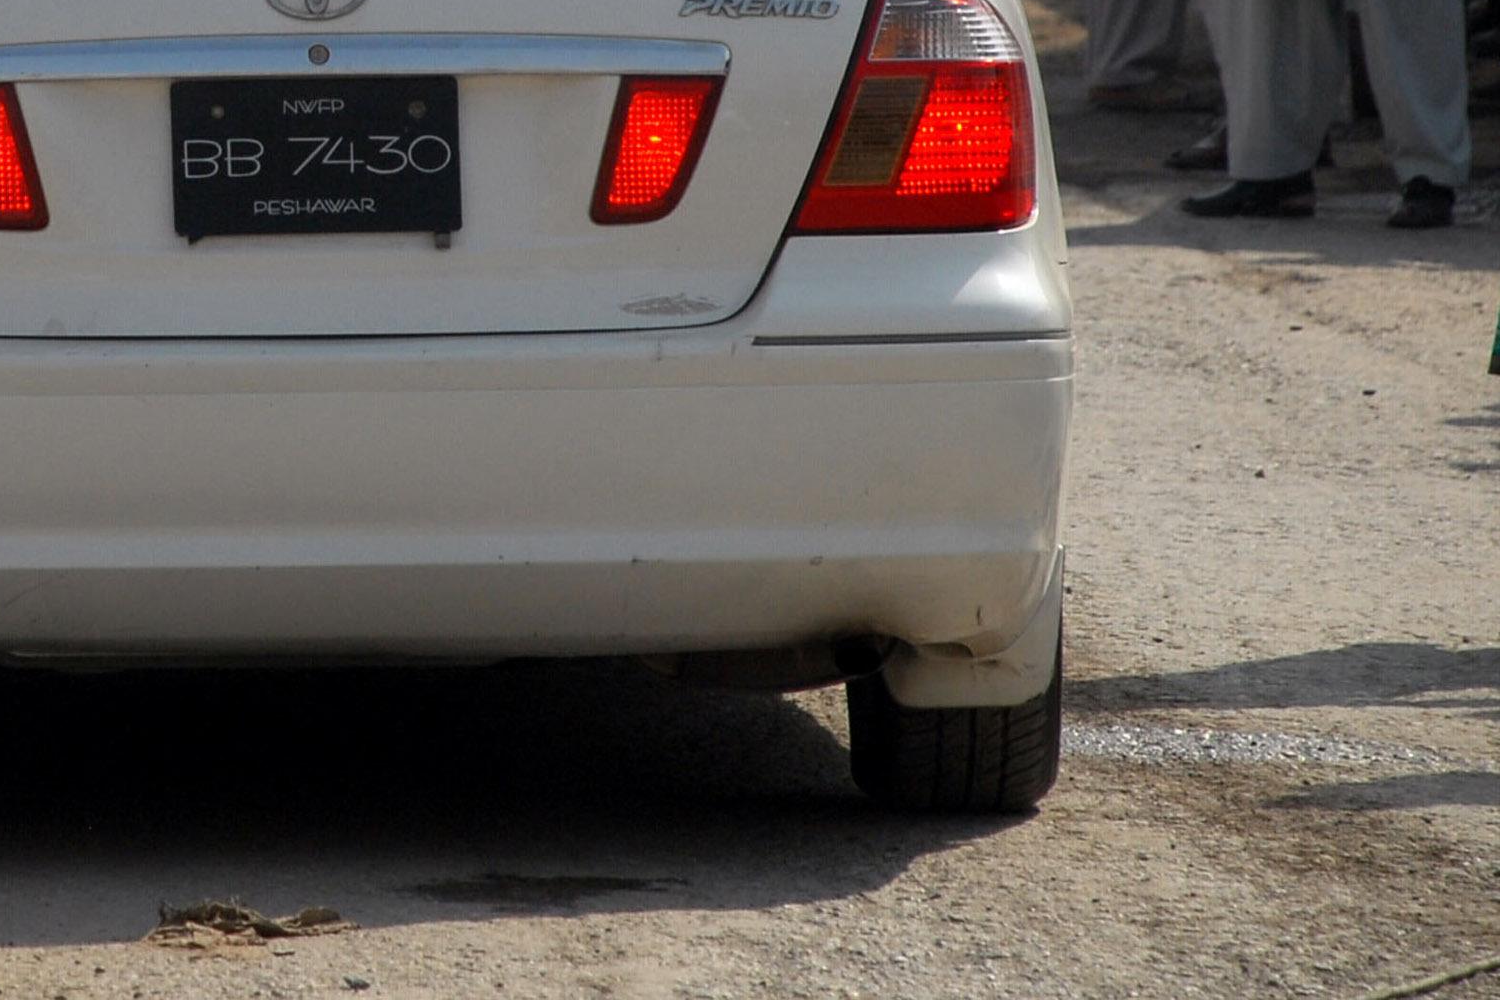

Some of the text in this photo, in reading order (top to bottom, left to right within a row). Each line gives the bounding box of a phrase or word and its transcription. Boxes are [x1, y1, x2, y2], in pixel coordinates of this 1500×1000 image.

[282, 99, 345, 115] NWFP
[181, 134, 452, 178] BB 7430
[253, 197, 376, 216] PESHAWAR
